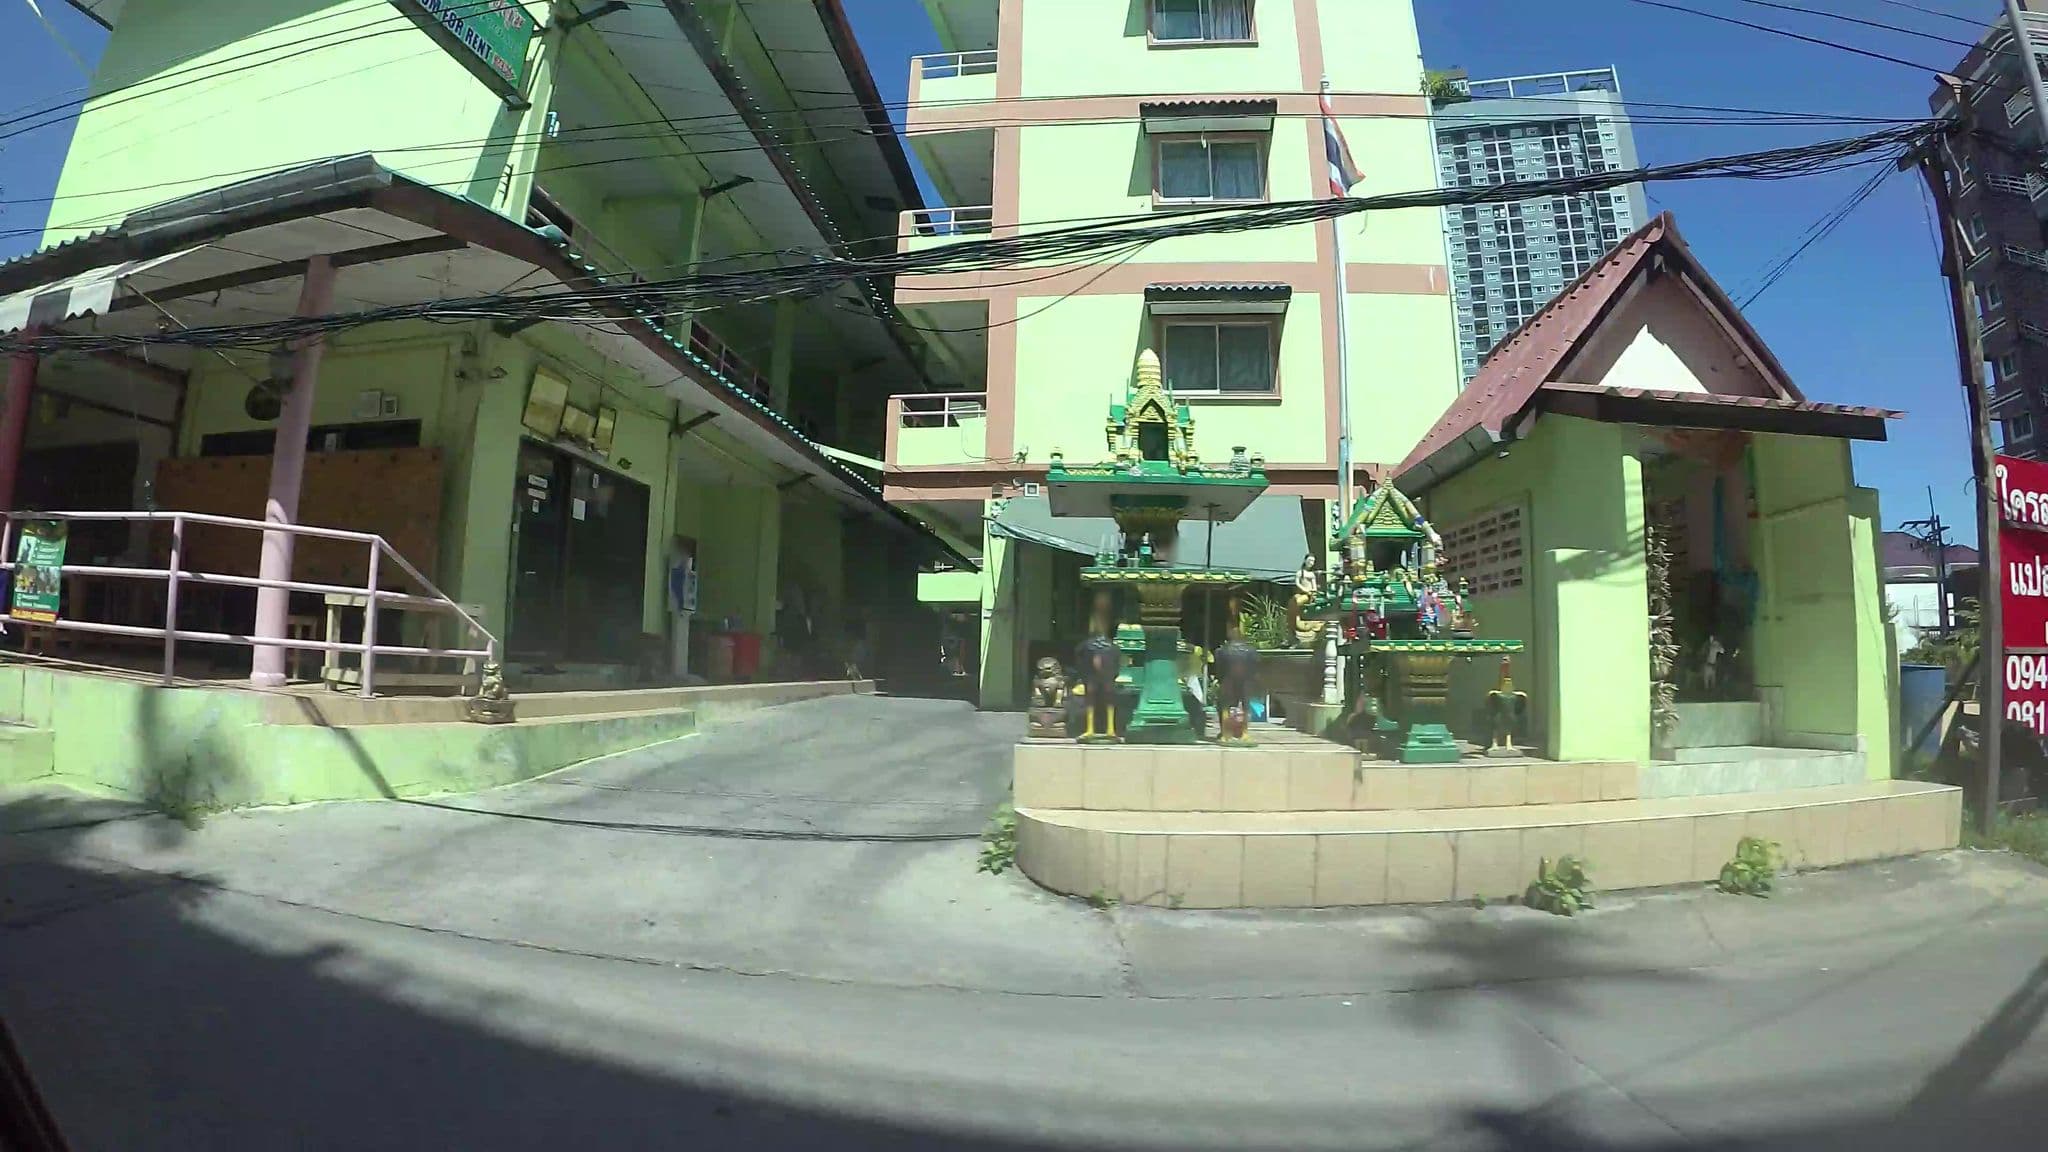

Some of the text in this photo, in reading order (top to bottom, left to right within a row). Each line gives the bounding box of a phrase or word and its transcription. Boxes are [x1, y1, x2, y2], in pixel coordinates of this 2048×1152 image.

[442, 10, 464, 36] FOR
[465, 27, 492, 60] RENT
[2006, 655, 2048, 690] 094
